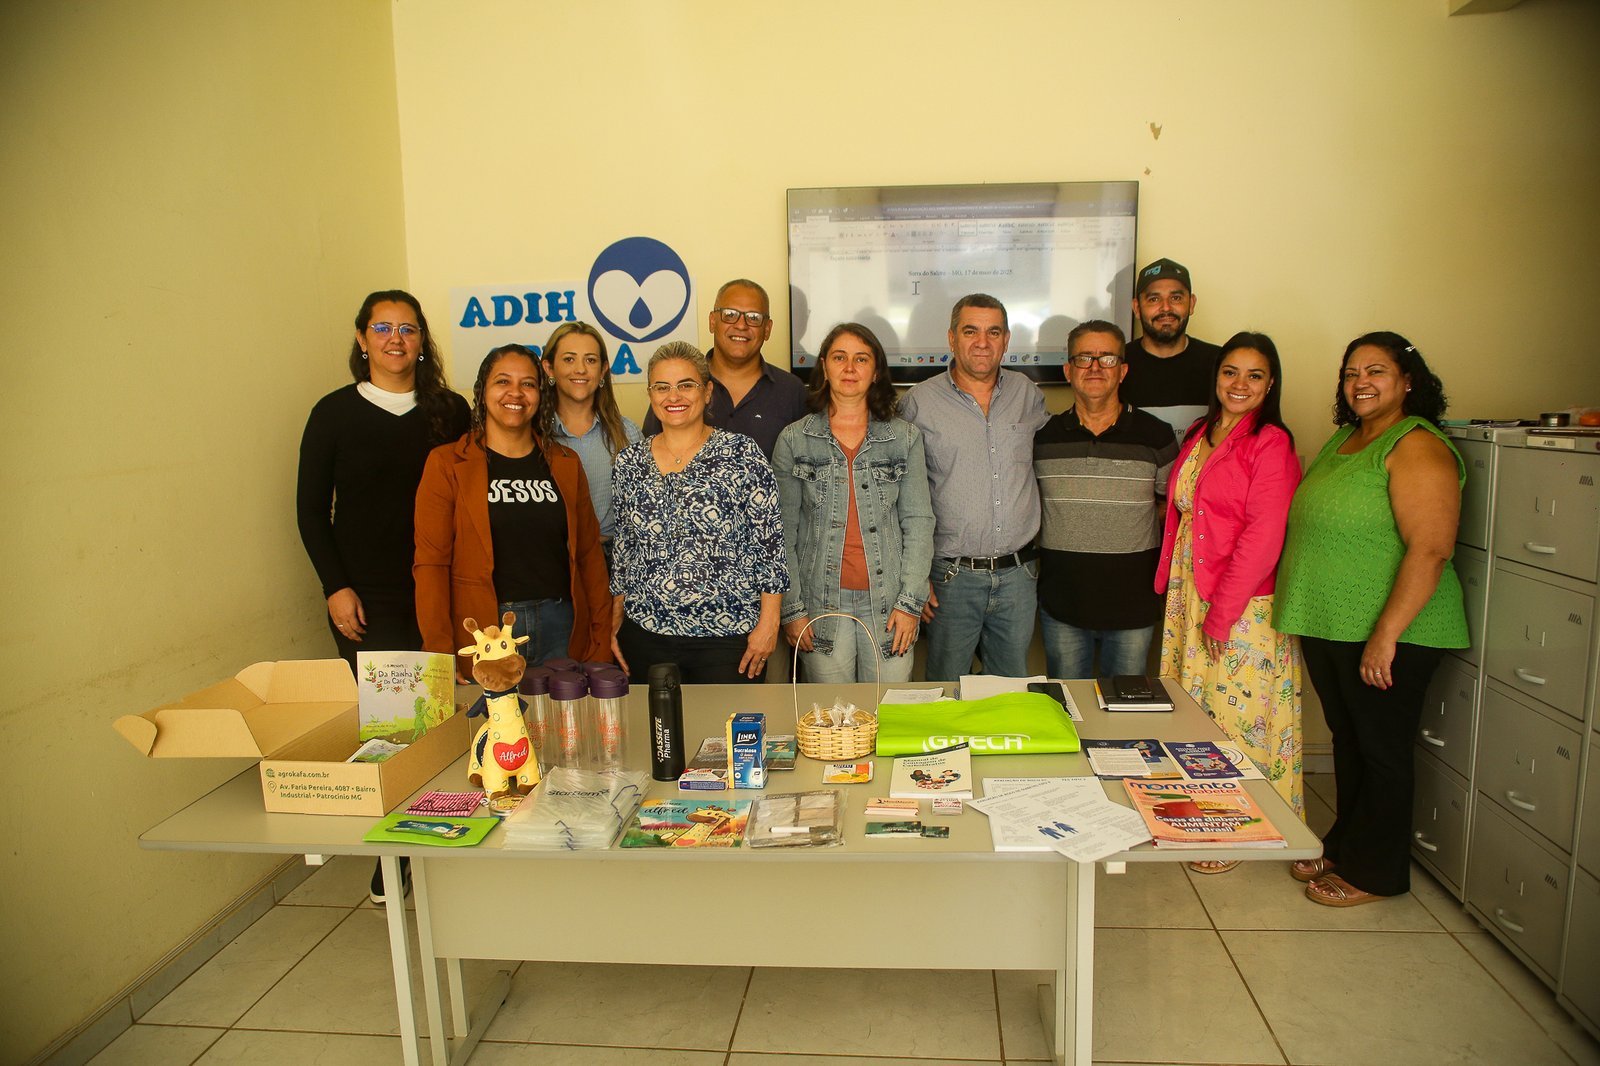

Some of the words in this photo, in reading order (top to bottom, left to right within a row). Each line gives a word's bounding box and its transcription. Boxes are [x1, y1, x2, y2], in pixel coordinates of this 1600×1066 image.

[459, 290, 577, 328] ADIH
[488, 479, 558, 502] JESUS
[736, 732, 756, 743] LINEA
[1130, 782, 1236, 790] momento
